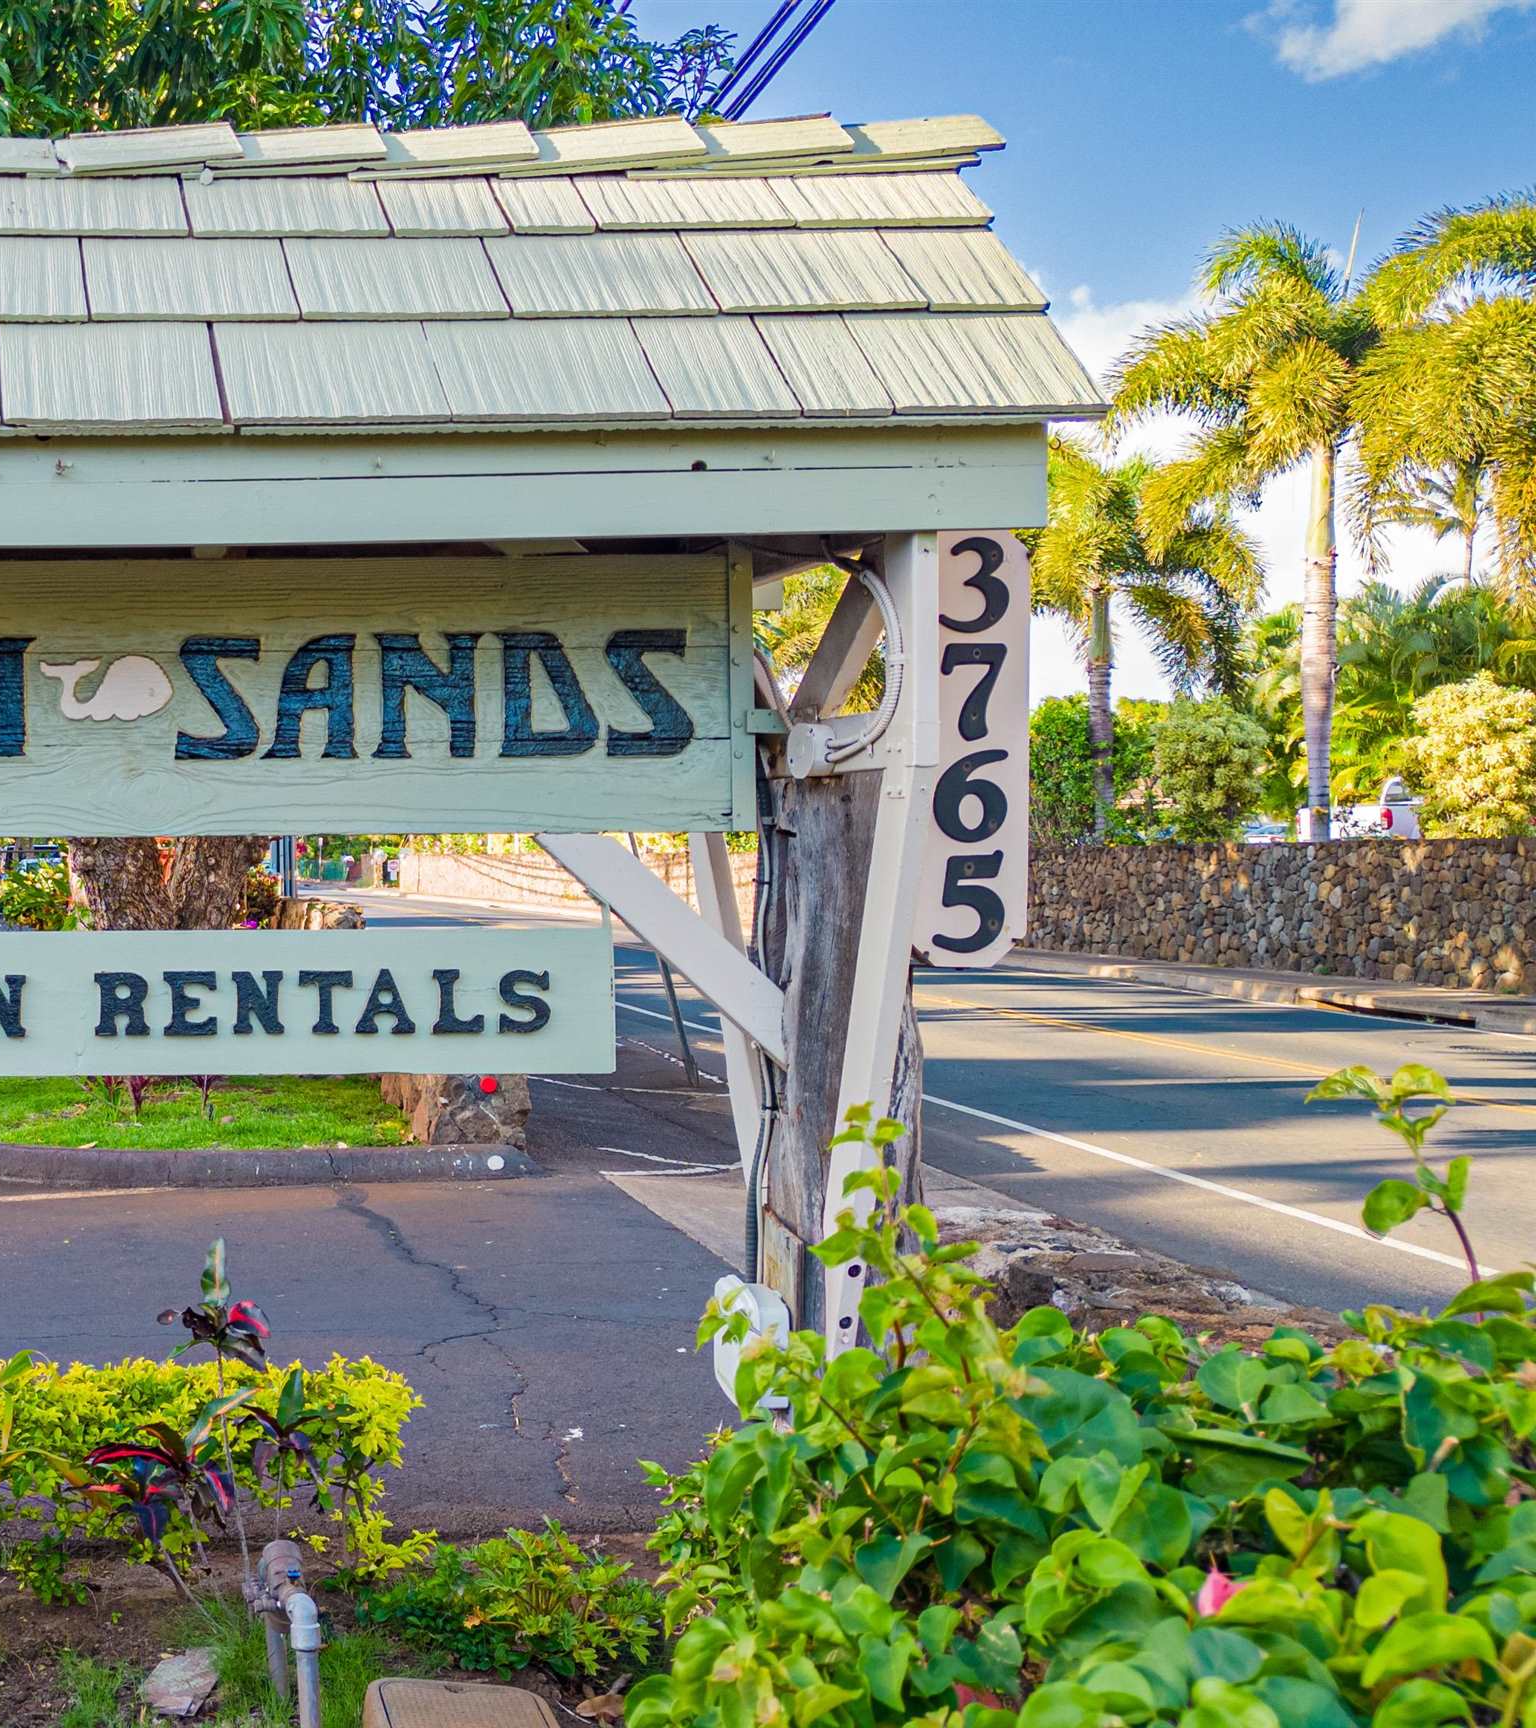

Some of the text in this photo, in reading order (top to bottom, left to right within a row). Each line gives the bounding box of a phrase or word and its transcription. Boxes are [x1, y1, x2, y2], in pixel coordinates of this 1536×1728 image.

[174, 629, 695, 760] SANDS
[931, 536, 1010, 954] 3765
[94, 968, 552, 1036] RENTALS
